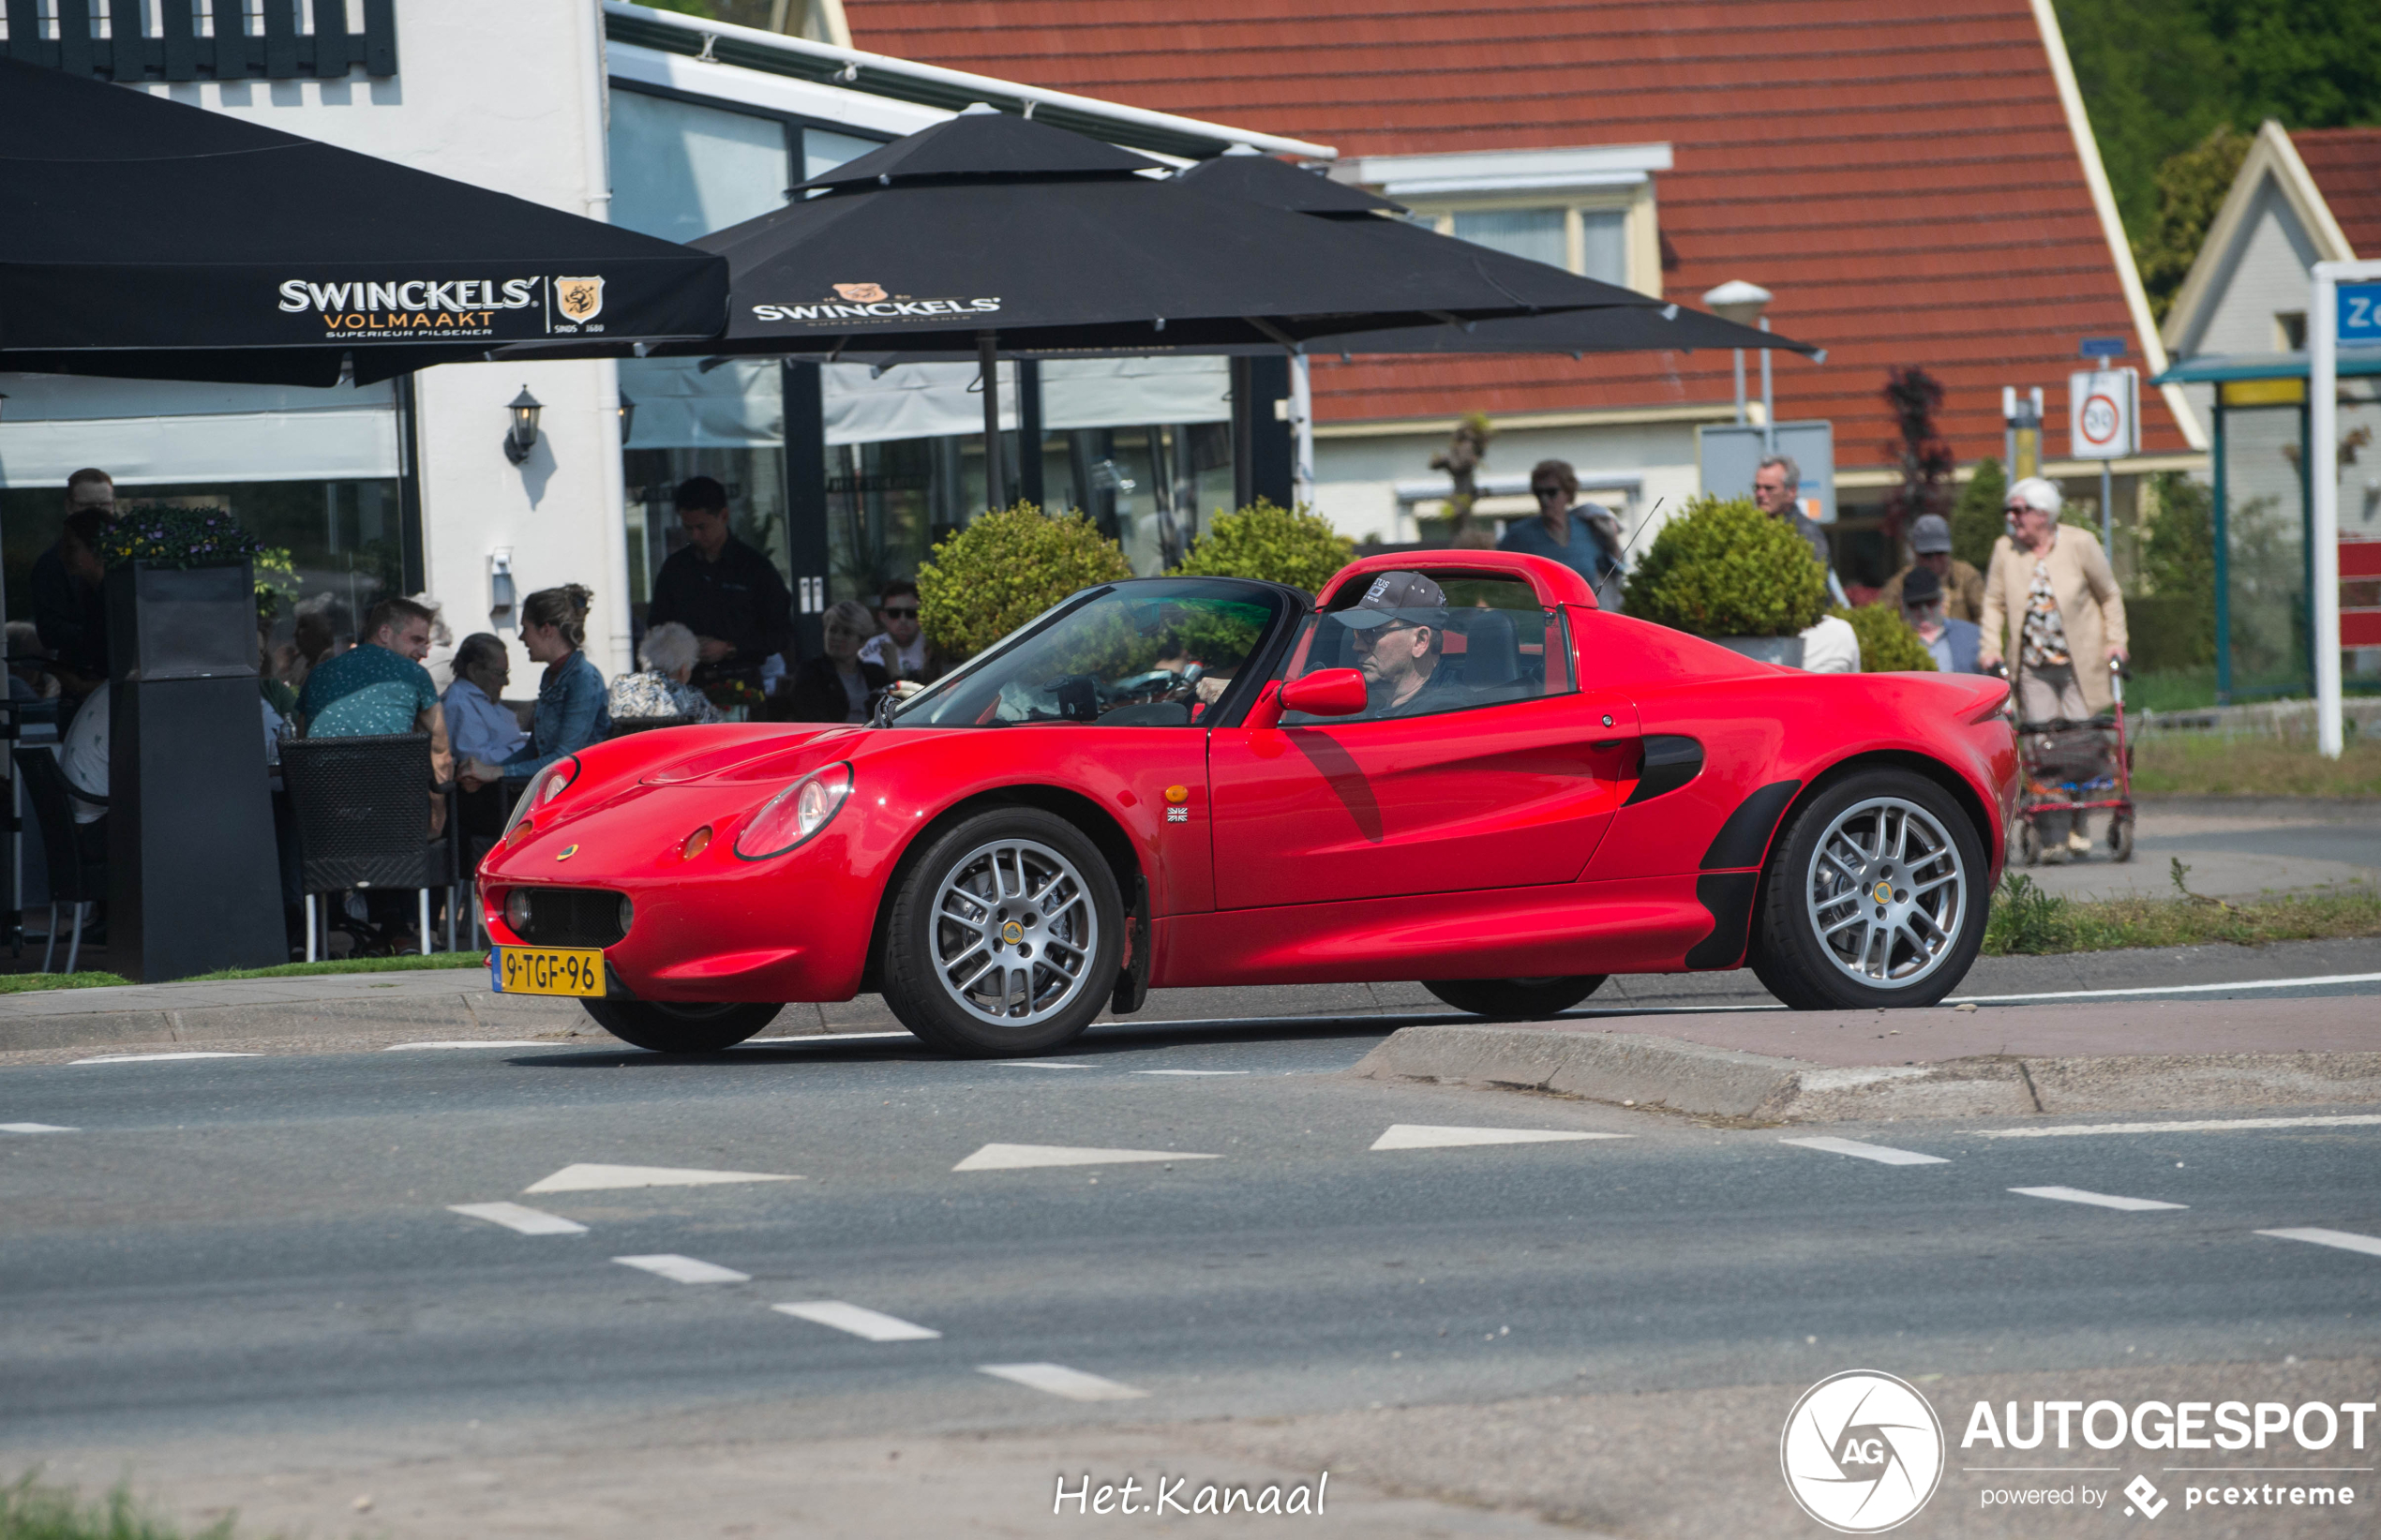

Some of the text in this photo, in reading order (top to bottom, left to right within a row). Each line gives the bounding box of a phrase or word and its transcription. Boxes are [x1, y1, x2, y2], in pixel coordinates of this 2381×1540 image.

[278, 276, 541, 312] SWINCKELS'
[324, 312, 495, 329] VOLMAAKT
[752, 297, 1001, 321] SWINCKELS'
[325, 328, 493, 338] SUPERIEUR PILSENER
[506, 952, 595, 990] 9-TGF-96
